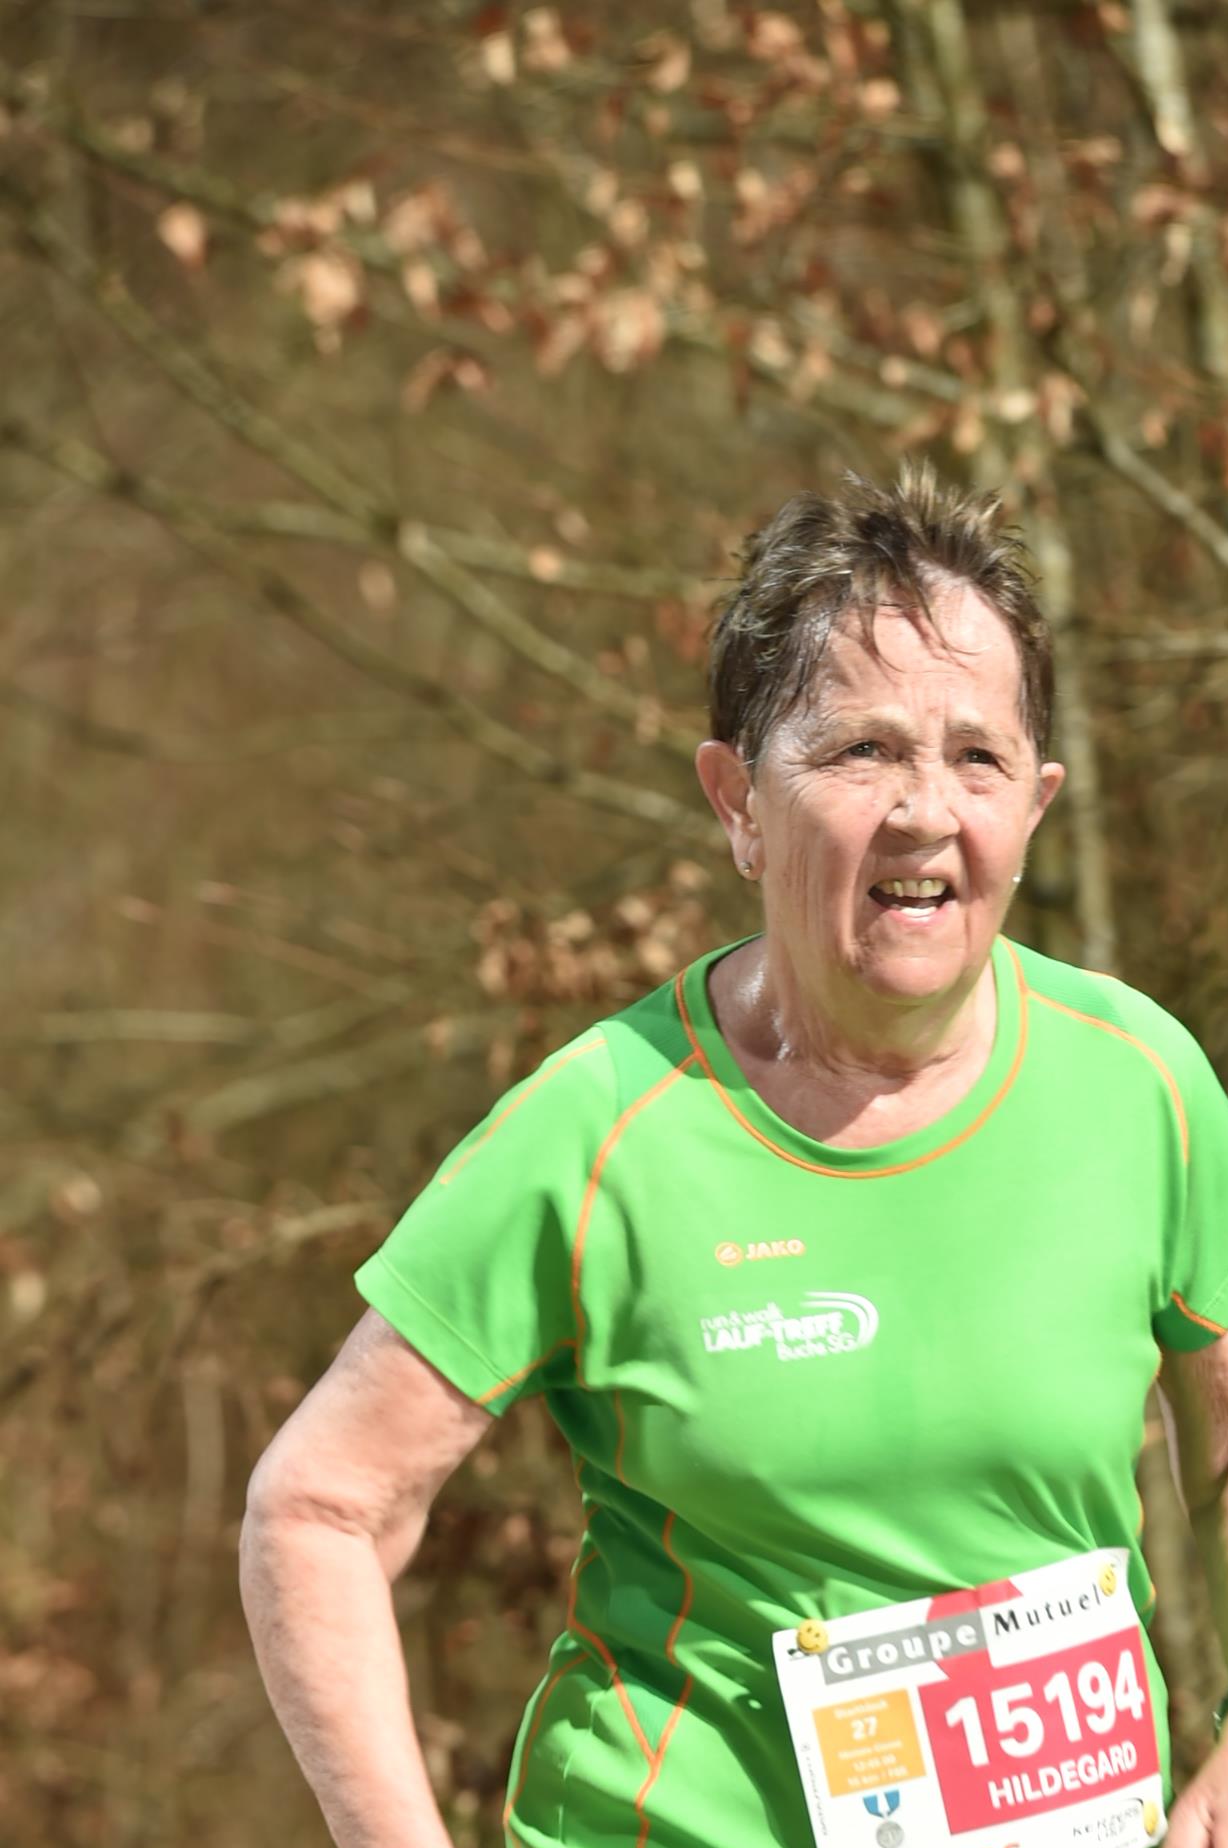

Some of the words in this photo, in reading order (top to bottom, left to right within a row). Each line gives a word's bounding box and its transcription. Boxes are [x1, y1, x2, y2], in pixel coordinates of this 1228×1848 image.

[747, 1239, 805, 1261] JAKO
[827, 1622, 978, 1675] Groupe
[993, 1583, 1101, 1636] Mutuel
[850, 1715, 878, 1741] 27
[945, 1648, 1145, 1768] 15194
[988, 1741, 1138, 1809] HILDEGARD
